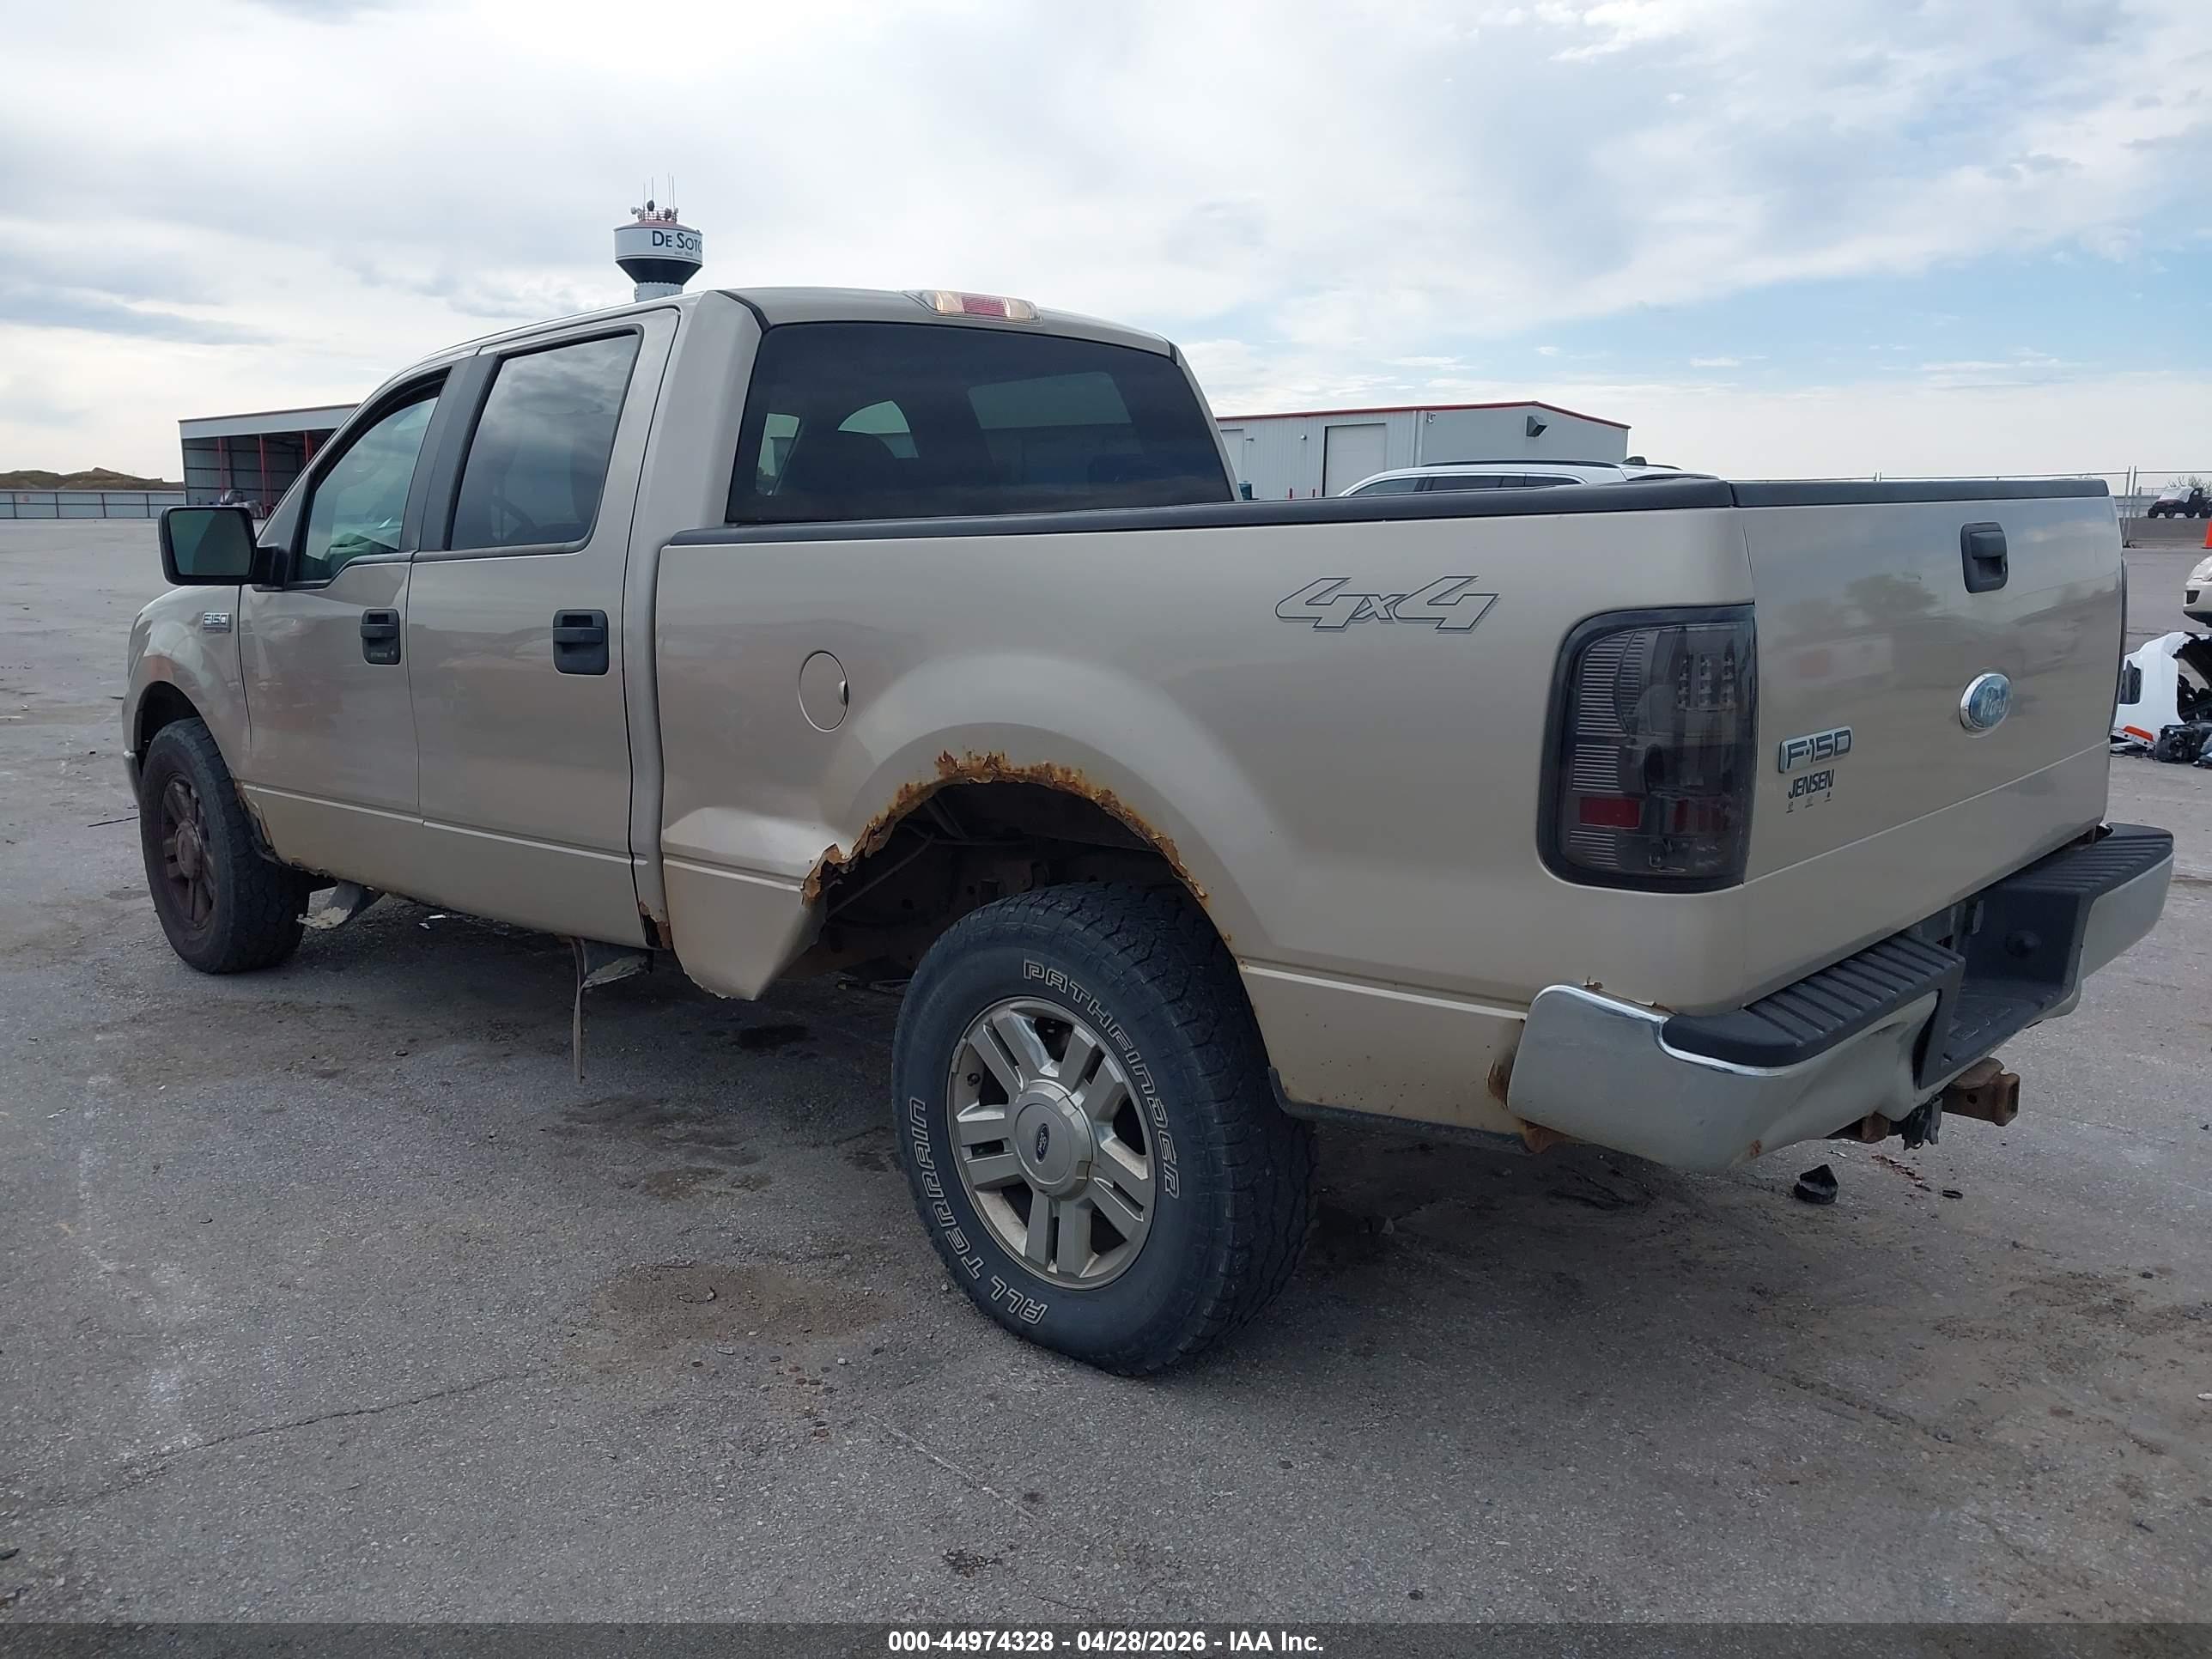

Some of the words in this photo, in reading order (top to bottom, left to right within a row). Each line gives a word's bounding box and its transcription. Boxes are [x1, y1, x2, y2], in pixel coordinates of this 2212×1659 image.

[1788, 769, 1835, 799] JENSEN
[1023, 958, 1181, 1200] PATHFINDER
[908, 1096, 985, 1280] TERRAIN
[989, 1274, 1048, 1326] ALL
